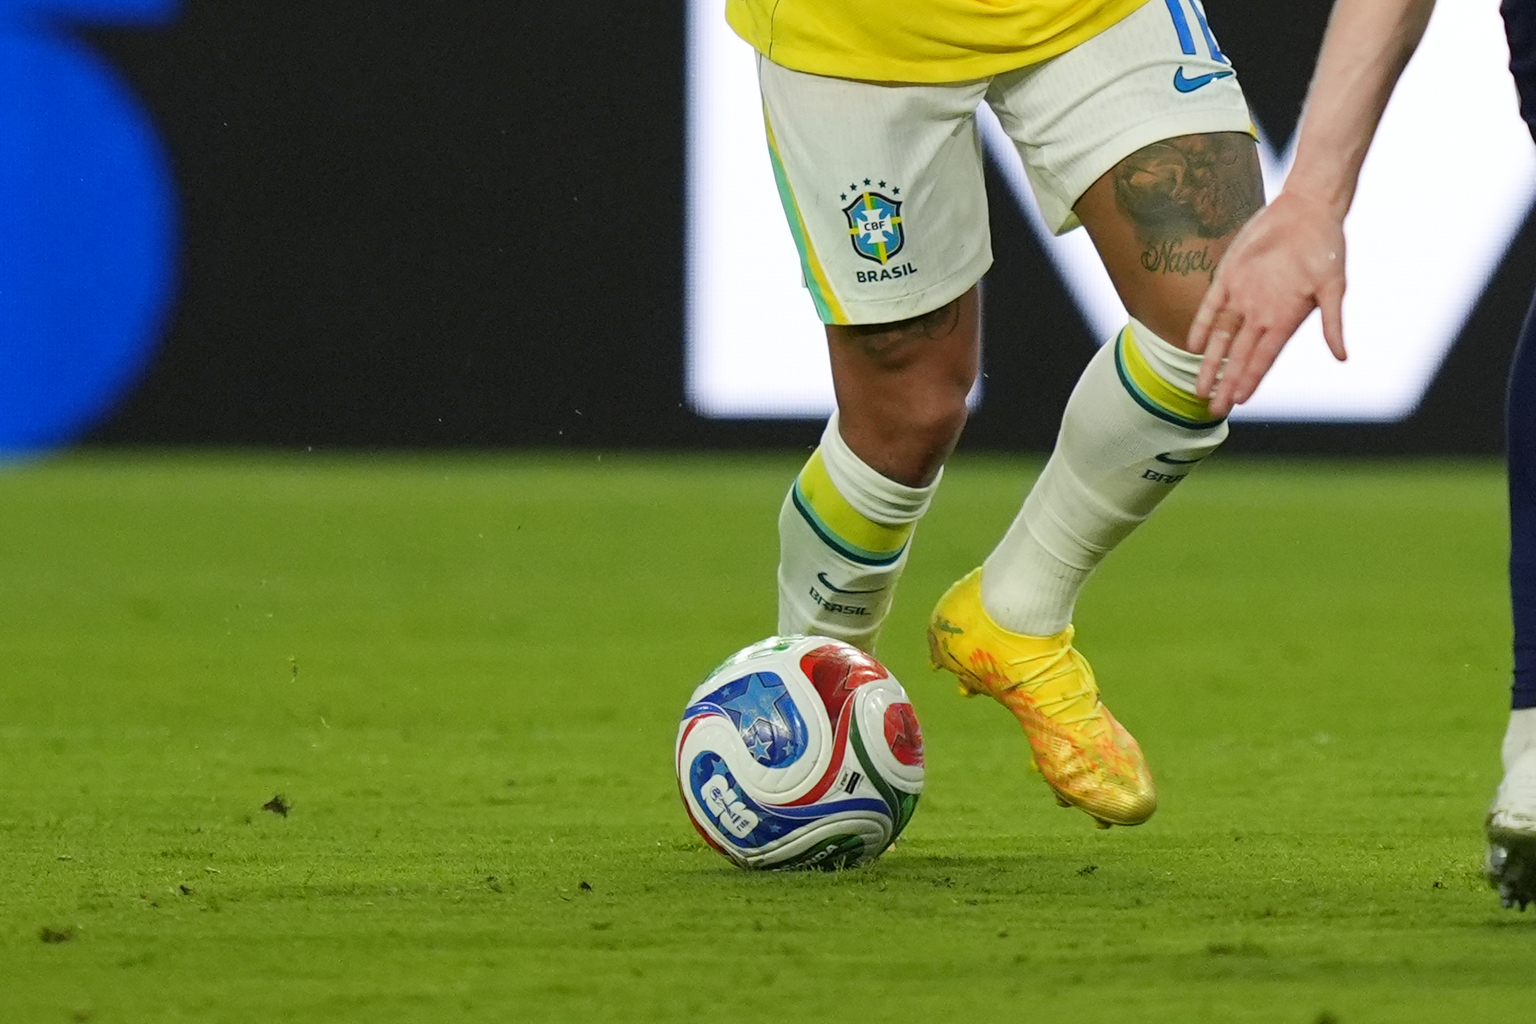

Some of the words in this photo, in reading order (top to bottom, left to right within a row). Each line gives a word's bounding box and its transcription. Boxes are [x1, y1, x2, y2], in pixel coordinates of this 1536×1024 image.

[863, 220, 886, 232] CBF
[856, 262, 918, 283] BRASIL
[808, 585, 872, 616] BRASIL
